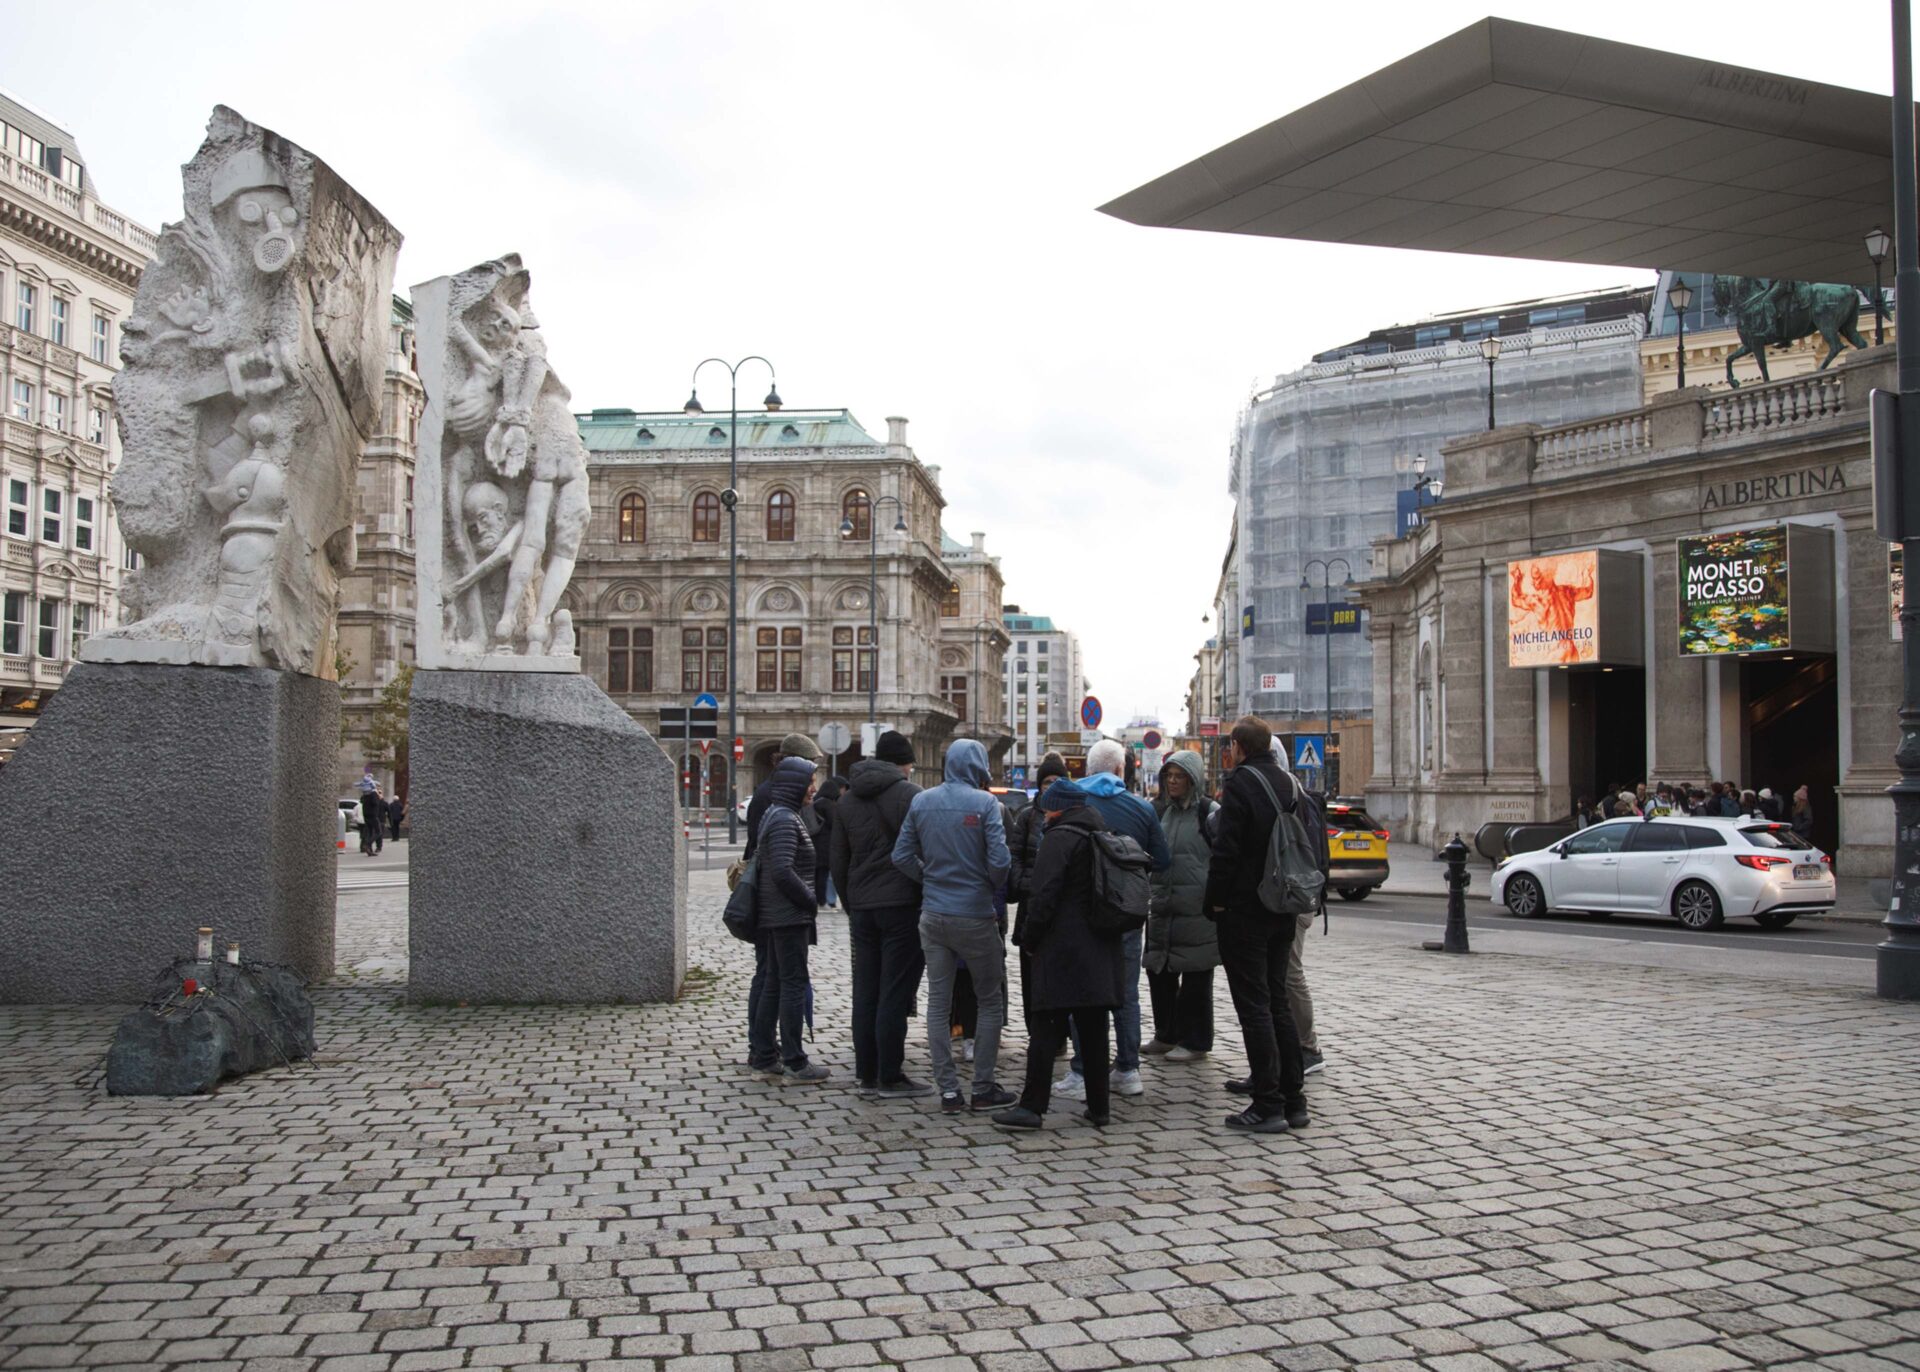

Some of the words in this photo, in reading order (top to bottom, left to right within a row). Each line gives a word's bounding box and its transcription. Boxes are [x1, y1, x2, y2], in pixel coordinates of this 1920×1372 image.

[1699, 67, 1808, 105] ALBERTINA
[1703, 465, 1846, 510] ALBERTINA
[1687, 559, 1753, 583] MONET
[1753, 565, 1768, 575] BIS
[1687, 577, 1764, 601] PICASSO
[1513, 626, 1593, 645] MICHELANGELO
